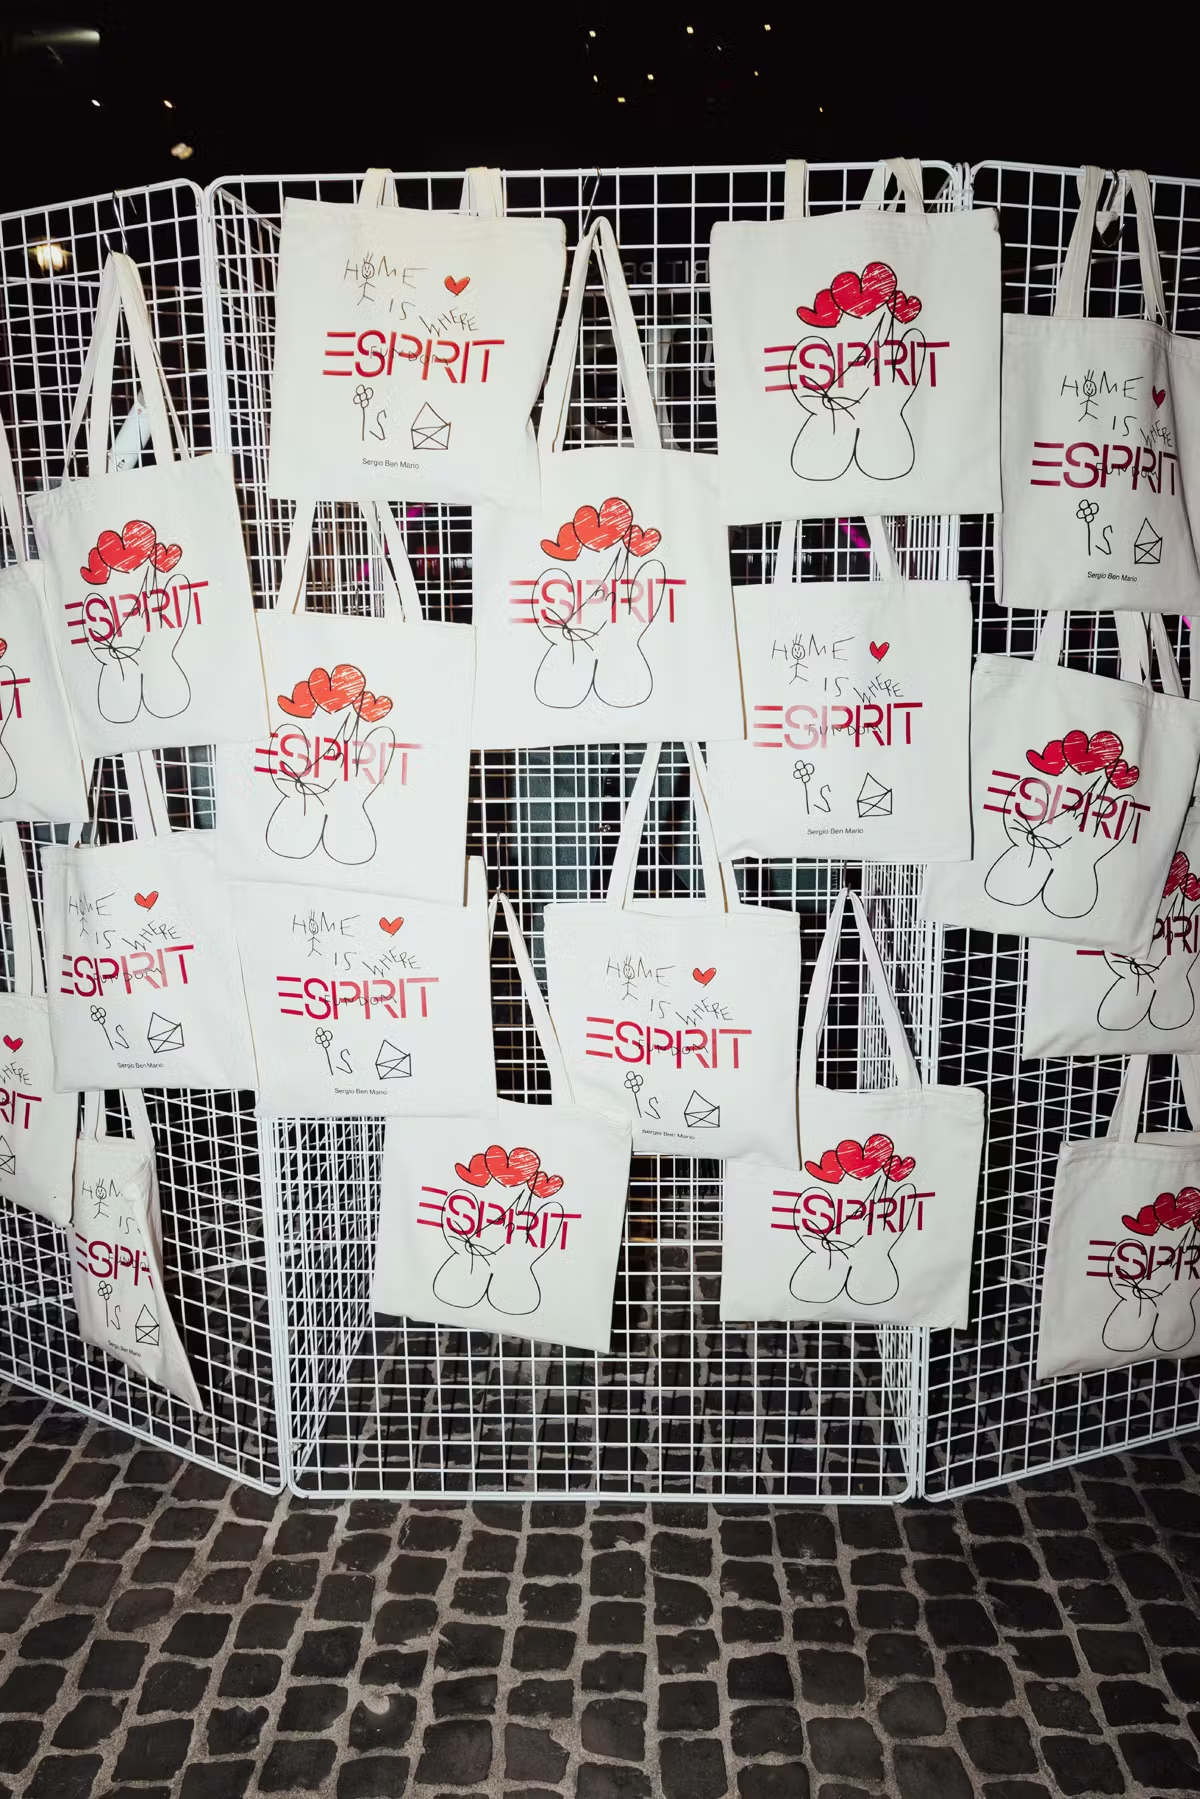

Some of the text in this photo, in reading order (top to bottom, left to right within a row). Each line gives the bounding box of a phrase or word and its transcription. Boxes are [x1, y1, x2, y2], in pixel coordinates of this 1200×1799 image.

[389, 298, 478, 337] IS WHERE
[322, 329, 505, 384] ESPRIT
[763, 340, 950, 392] ESPRIT
[1112, 415, 1173, 448] IS WHERE
[362, 457, 420, 470] Sergio Ben Mario
[1030, 441, 1178, 496] ESPRIT
[1087, 571, 1138, 583] Sergio Ben Mario
[64, 580, 209, 645] ESPRIT
[509, 578, 687, 625] ESPRIT
[823, 673, 904, 704] IS WHERE
[752, 702, 923, 750] ESPRIT
[254, 732, 423, 785] ESPRIT
[983, 769, 1151, 844] ESPRIT
[807, 828, 829, 836] Sergio
[844, 827, 864, 835] Mario
[95, 920, 181, 951] IS WHERE
[60, 944, 194, 998] ESPRIT
[334, 947, 421, 977] IS WHERE
[276, 975, 439, 1020] ESPRIT
[650, 996, 733, 1027] IS WHERE
[585, 1016, 752, 1070] ESPRIT
[334, 1088, 355, 1096] Sergio
[416, 1186, 582, 1250] ESPRIT
[770, 1190, 936, 1236] ESPRIT
[1086, 1239, 1200, 1281] ESPR
